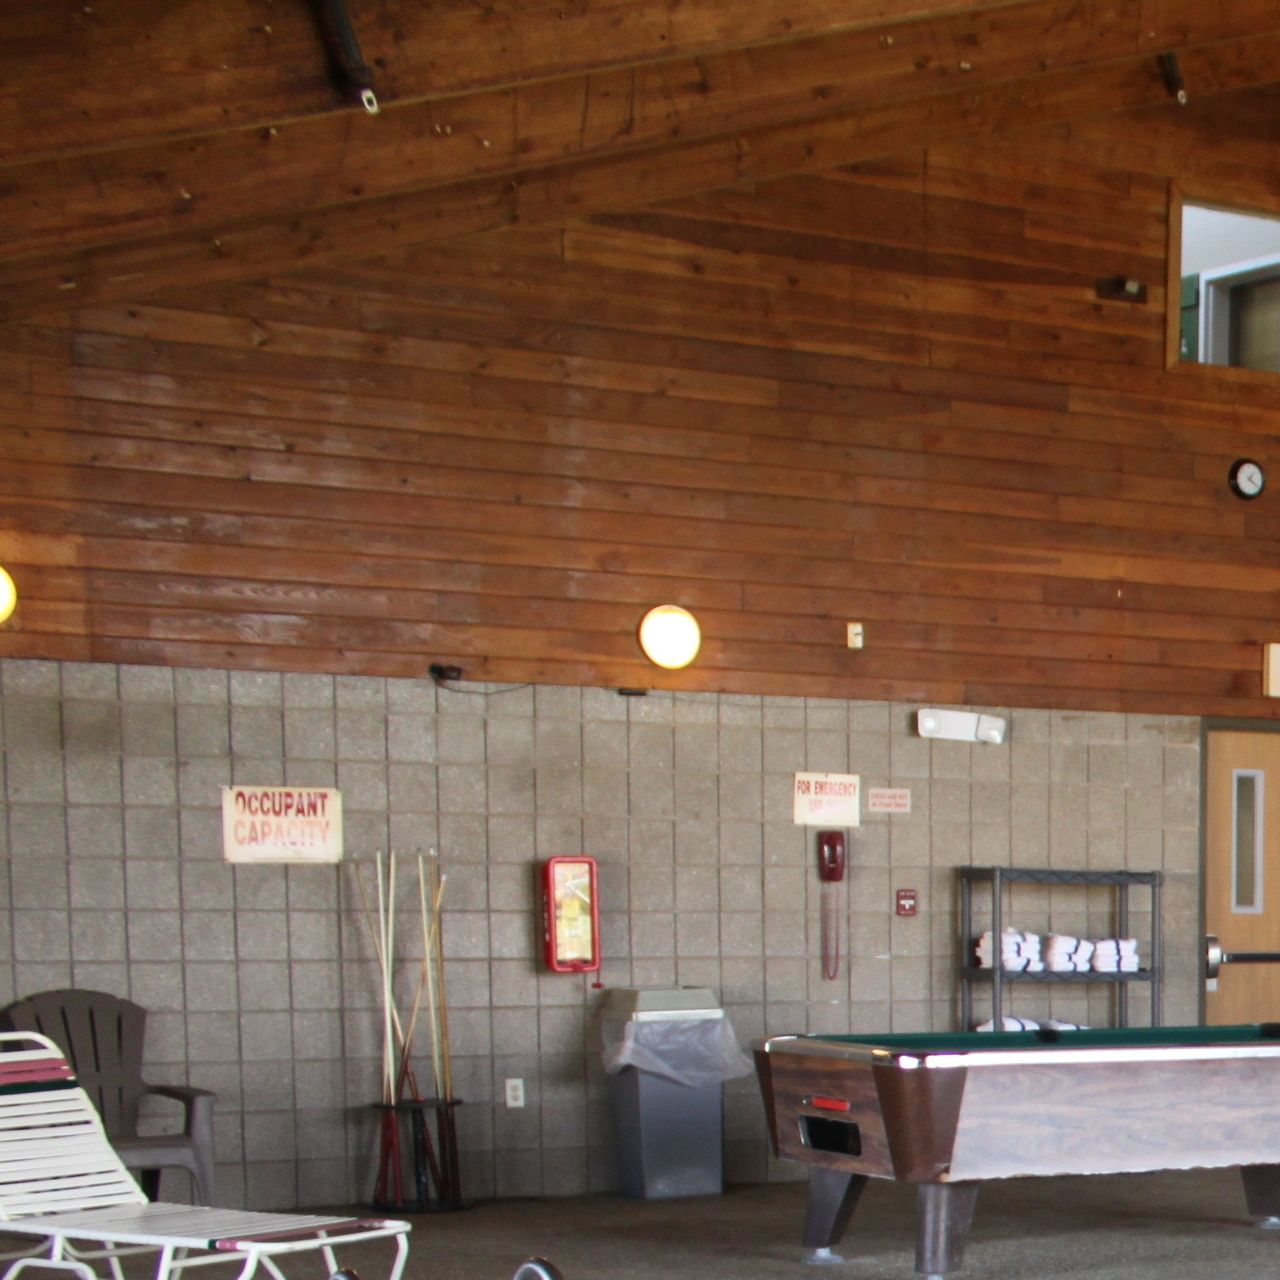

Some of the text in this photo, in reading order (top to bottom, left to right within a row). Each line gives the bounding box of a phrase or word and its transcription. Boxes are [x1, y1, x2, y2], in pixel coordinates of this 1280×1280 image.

[797, 780, 856, 797] FOR EMERGENCY
[235, 790, 328, 817] OCCUPANT
[234, 819, 330, 846] CAPACITY
